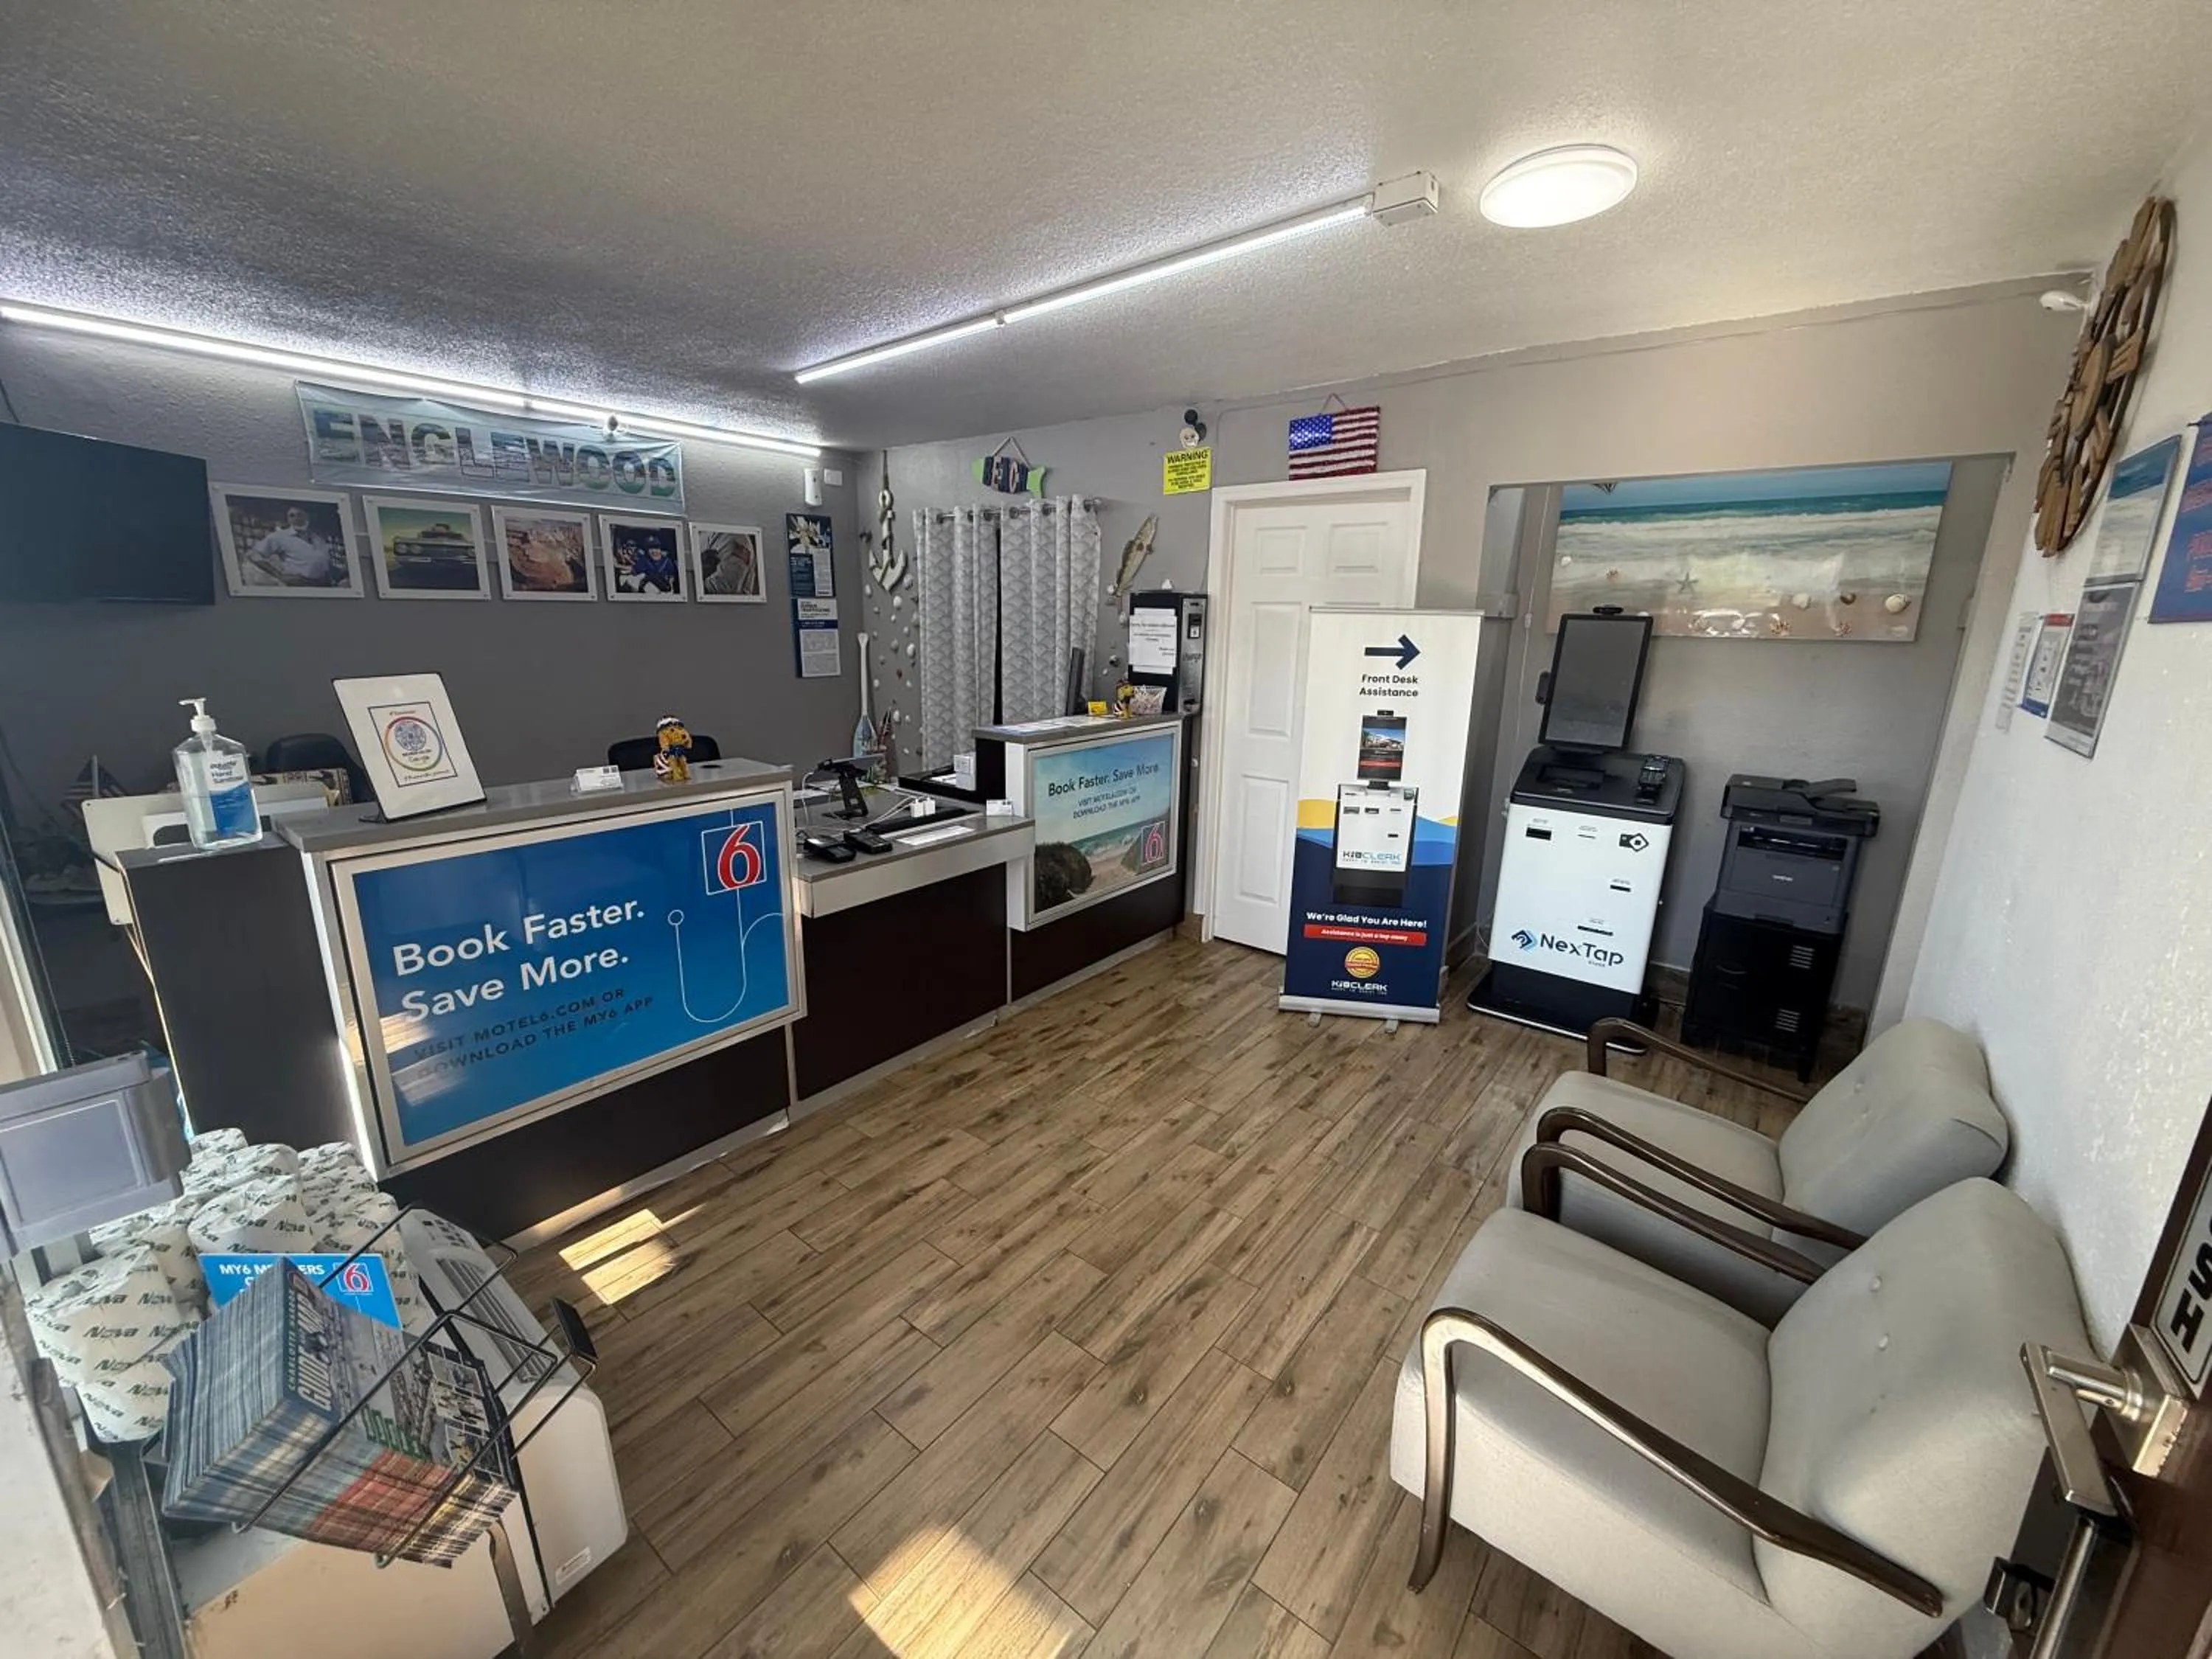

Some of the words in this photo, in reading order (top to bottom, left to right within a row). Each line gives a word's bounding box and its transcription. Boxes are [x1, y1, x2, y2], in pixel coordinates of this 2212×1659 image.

[313, 410, 676, 497] ENGLEWOOD
[1168, 450, 1208, 464] WARNING
[1359, 687, 1419, 698] Assistance
[1362, 674, 1390, 684] Front
[1392, 675, 1418, 684] Desk
[1048, 779, 1076, 796] Book
[1113, 769, 1133, 782] Save
[716, 824, 762, 890] 6
[1307, 912, 1335, 920] We're
[1336, 914, 1359, 922] Glad
[1360, 917, 1380, 925] You
[1400, 919, 1427, 928] Here!
[392, 923, 510, 976] Book
[523, 897, 645, 944] Faster.
[1540, 933, 1624, 967] NexTap
[401, 978, 505, 1023] Save
[520, 945, 629, 990] More.
[414, 1036, 465, 1059] VISIT
[473, 997, 595, 1043] MOTEL6.COM
[602, 988, 624, 1002] OR
[417, 1034, 537, 1079] DOWNLOAD
[543, 1020, 576, 1040] THE
[583, 1011, 618, 1028] MY6
[625, 996, 654, 1015] APP
[219, 1264, 251, 1276] MY6
[344, 1262, 369, 1291] 6
[83, 1326, 139, 1338] Nova
[126, 1383, 169, 1397] Nov
[83, 1393, 125, 1418] Nova
